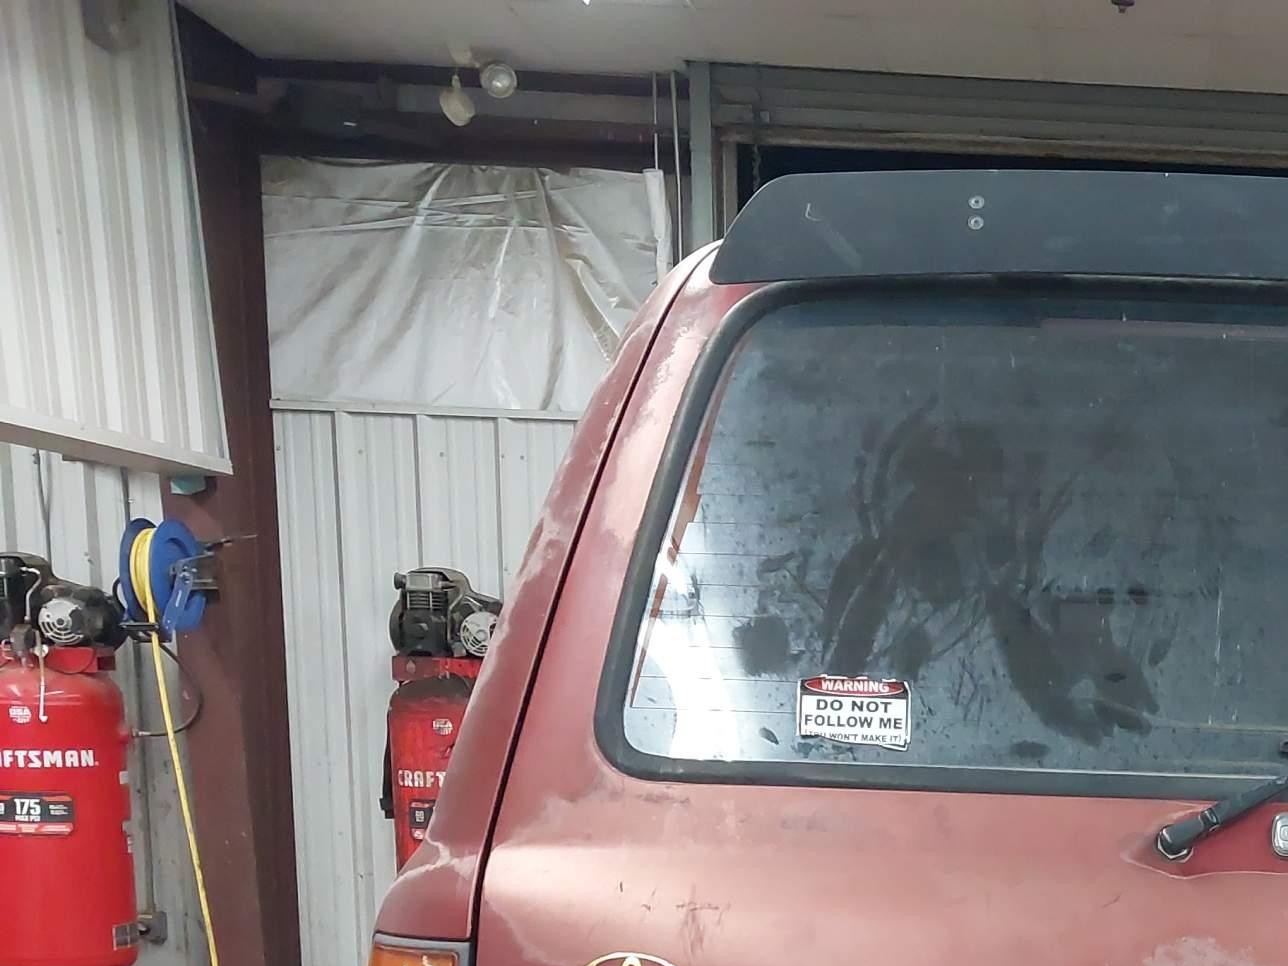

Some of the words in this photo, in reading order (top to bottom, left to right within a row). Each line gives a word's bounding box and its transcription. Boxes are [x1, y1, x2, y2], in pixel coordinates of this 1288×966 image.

[820, 680, 890, 692] WARNING
[816, 699, 843, 711] DO
[851, 701, 892, 713] NOT
[804, 714, 873, 728] FOLLOW
[879, 718, 903, 729] ME
[829, 733, 858, 741] WON'T
[861, 734, 888, 742] MAKE
[0, 750, 94, 767] FTSMAN
[14, 799, 41, 815] 175
